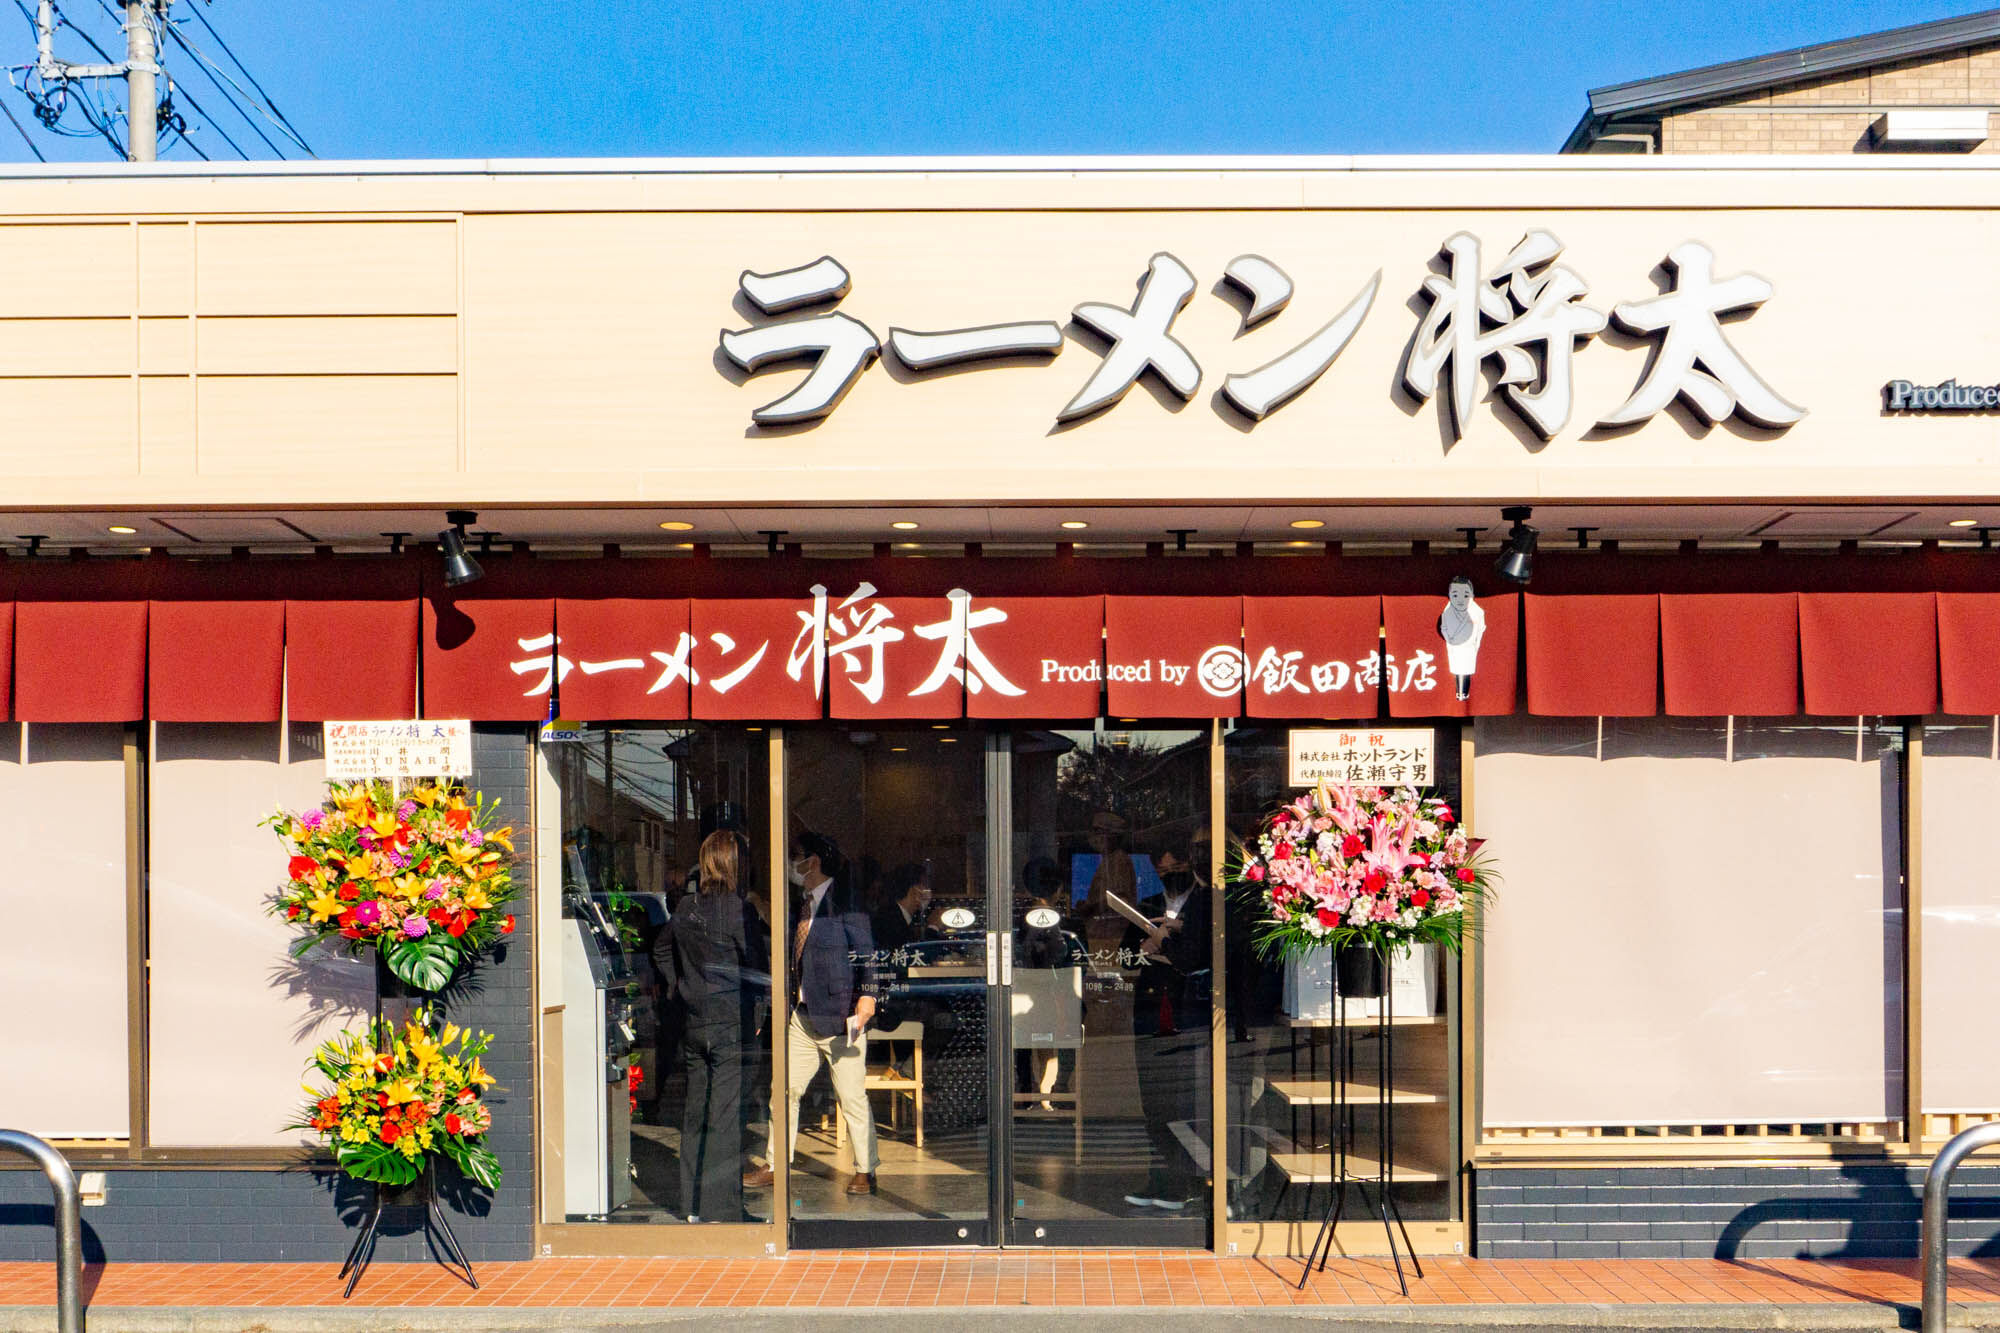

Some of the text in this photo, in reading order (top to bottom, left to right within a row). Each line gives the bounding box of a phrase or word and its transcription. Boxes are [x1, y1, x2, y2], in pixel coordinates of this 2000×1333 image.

[719, 228, 1811, 441] ラーメン将太
[1886, 378, 2000, 409] Produce
[510, 582, 1027, 704] ラーメン将太
[1041, 646, 1437, 694] Produced by 飯田商店
[542, 731, 580, 740] ALSOK
[1343, 747, 1427, 762] ホットランド
[1346, 764, 1427, 781] 佐瀬守男
[1071, 947, 1152, 967] ラーメン将太
